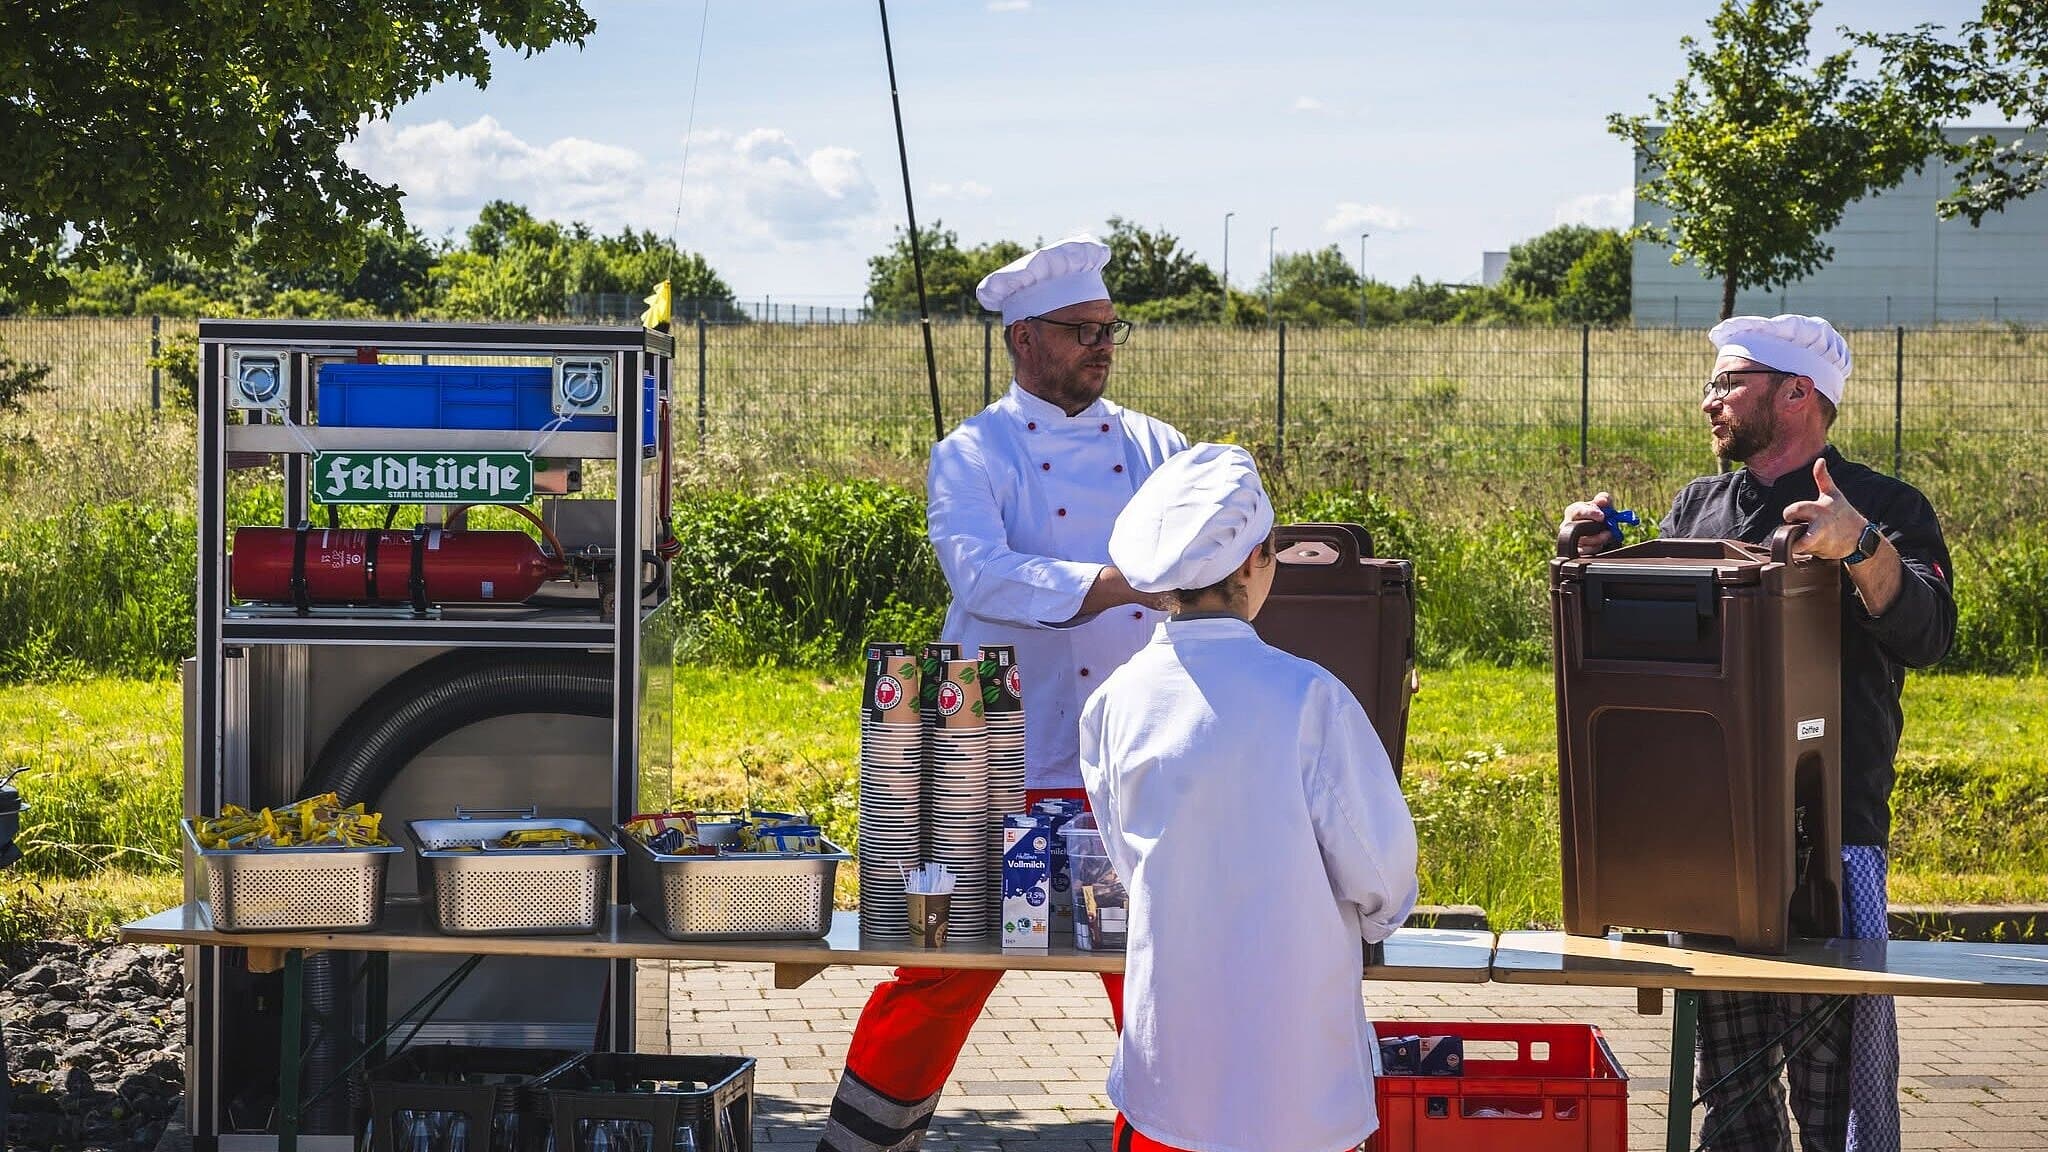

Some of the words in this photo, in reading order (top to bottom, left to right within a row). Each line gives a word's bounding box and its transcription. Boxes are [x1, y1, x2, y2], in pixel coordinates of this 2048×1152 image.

[325, 456, 521, 497] Feldküche
[1801, 725, 1820, 735] Coffee
[1007, 859, 1046, 869] Vollmilch
